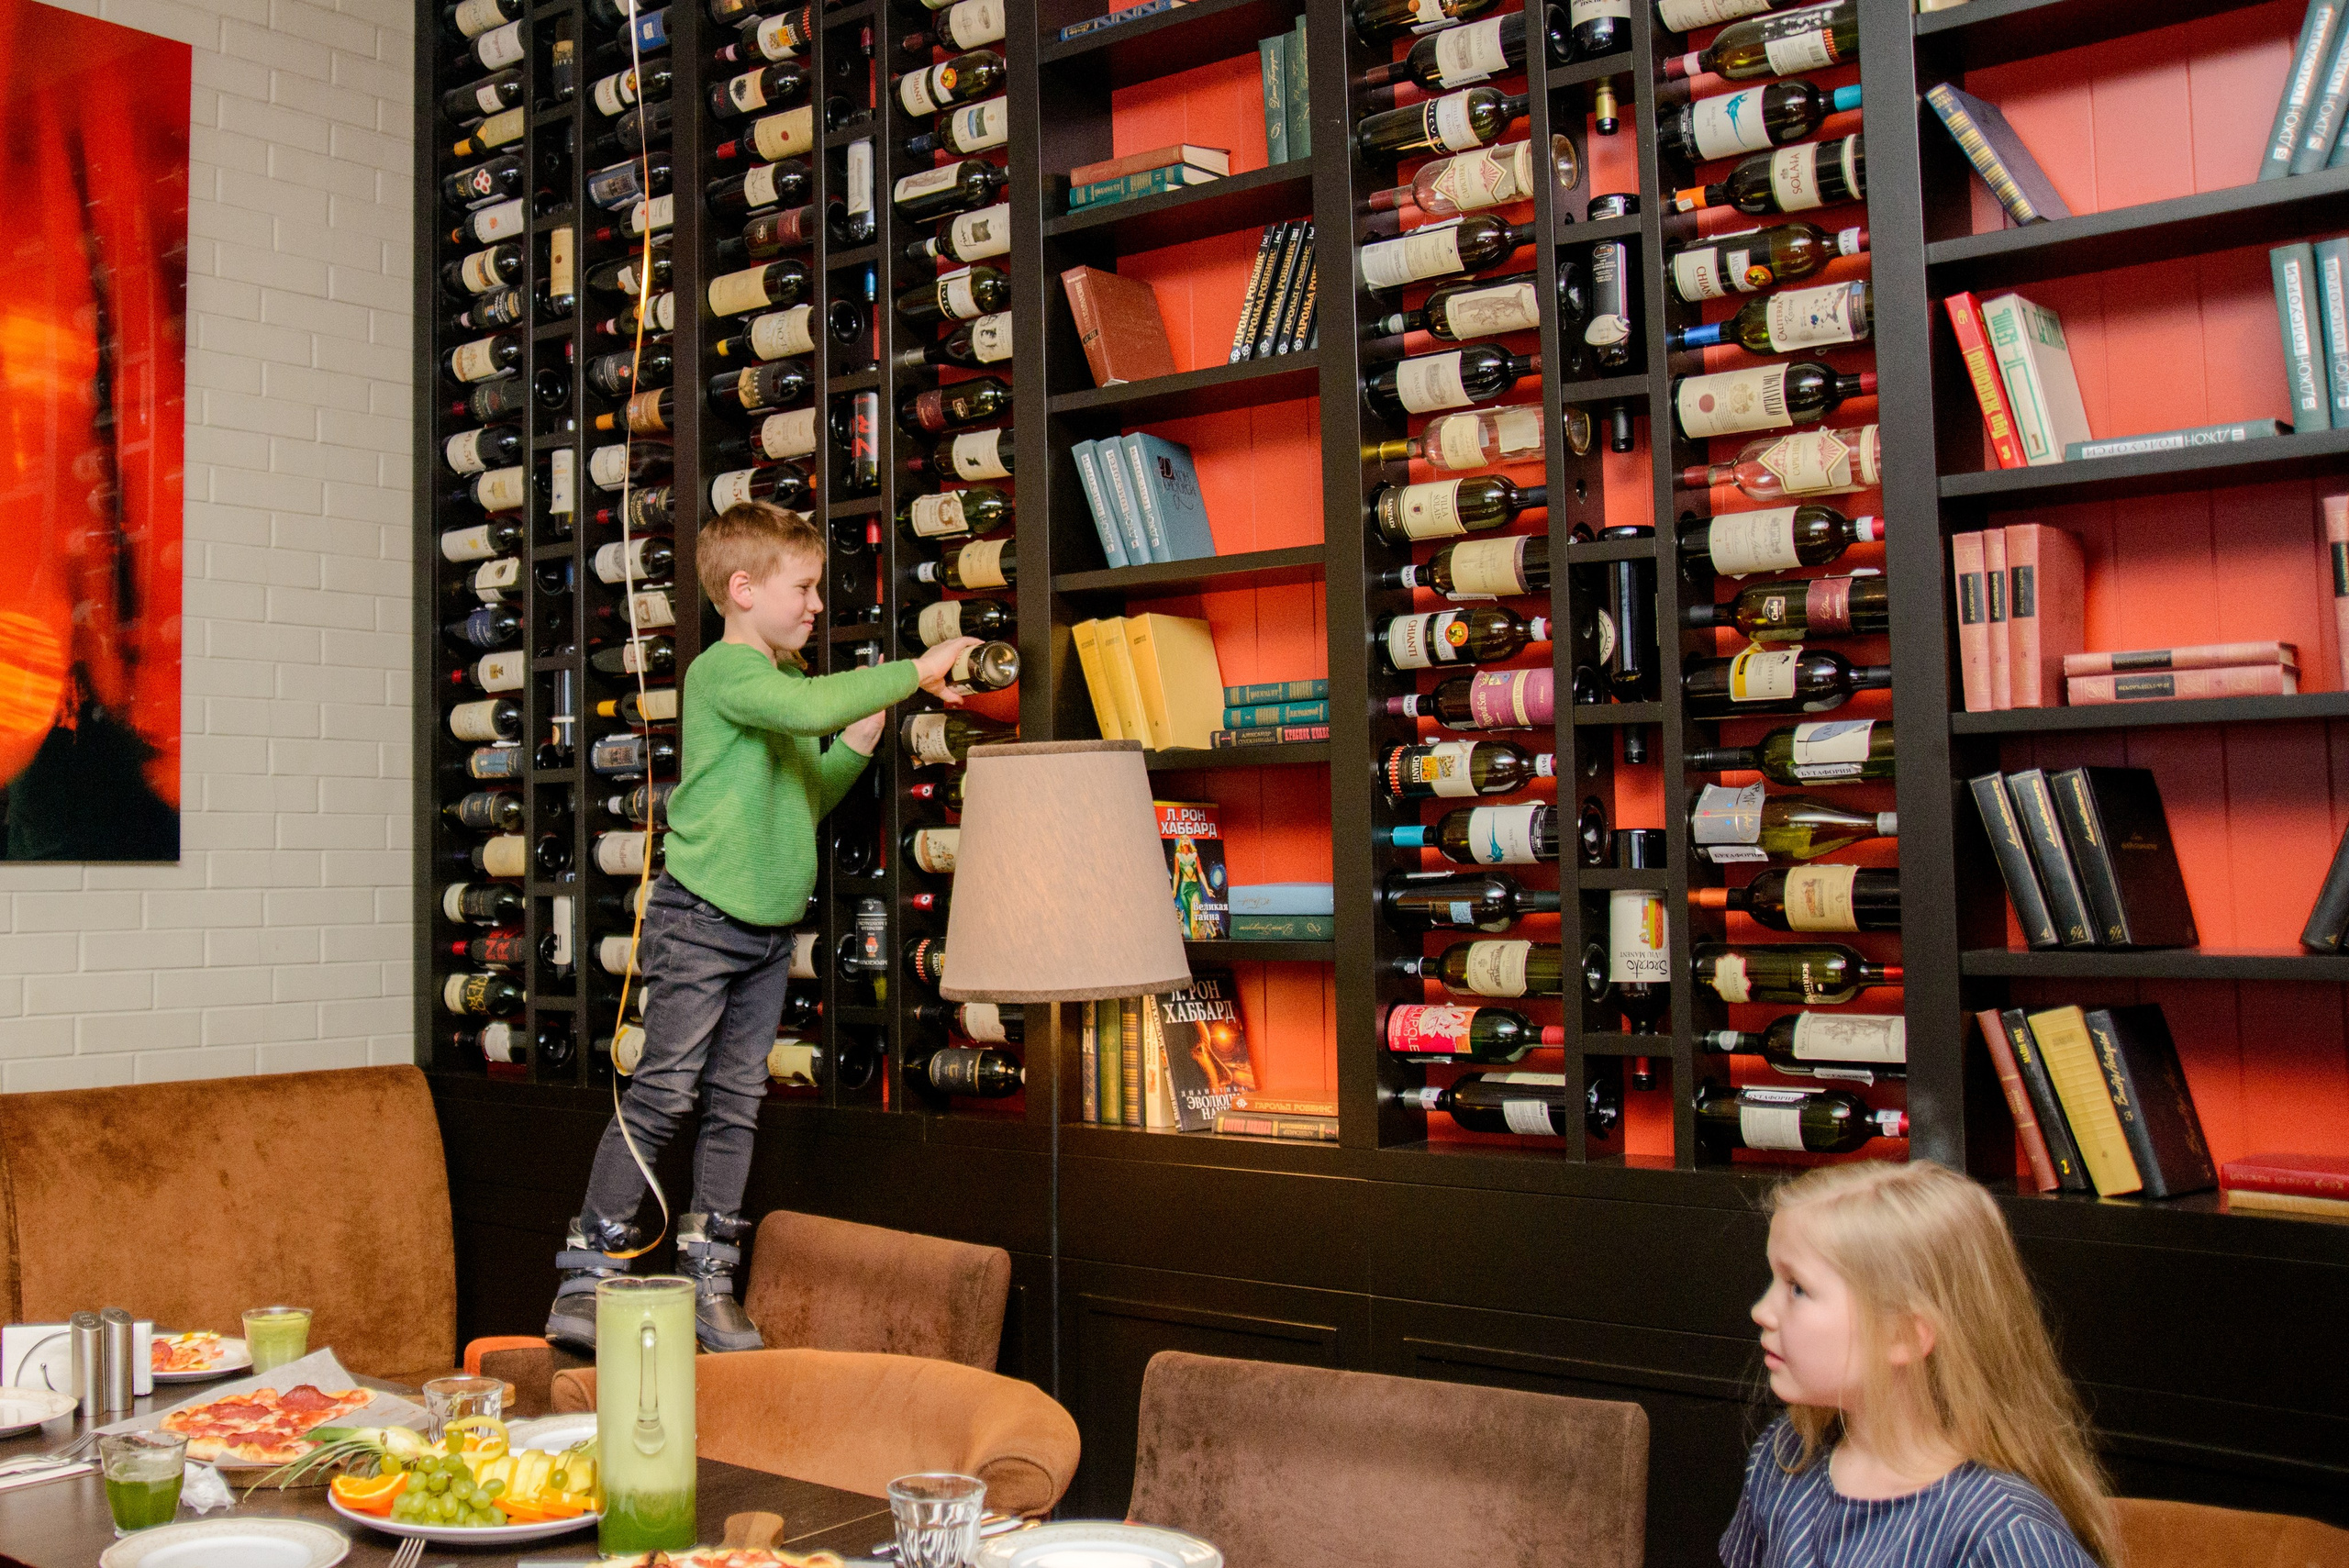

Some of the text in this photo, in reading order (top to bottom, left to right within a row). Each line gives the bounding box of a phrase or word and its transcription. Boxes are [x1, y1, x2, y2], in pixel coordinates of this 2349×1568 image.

[912, 73, 923, 105] CHIANTI
[2279, 7, 2332, 149] ДЖОН ГОЛСУОРСИ
[2317, 90, 2340, 137] ДЖОН
[1458, 163, 1470, 200] CAPICHERA
[1791, 152, 1803, 195] SOLAIA
[1232, 251, 1266, 347] ГАРОЛЬД РОББИНС
[1245, 249, 1276, 345] ГАРОЛЬД РОББИНС
[1264, 240, 1297, 337] ГАРОЛЬД РОББИНС
[1284, 245, 1311, 335] ГАРОЛЬД РОББИНС
[2324, 257, 2349, 354] ГОЛСУОРСИ
[1297, 290, 1312, 339] ГАРОЛЬД
[1776, 300, 1787, 342] CALITERRA
[2285, 260, 2315, 398] ДЖОН ГОЛСУОРСИ
[1764, 373, 1783, 417] TIGNANELLO
[1965, 350, 2000, 415] ЖАКОЛИО
[1793, 439, 1801, 476] CAPICHERA
[2082, 428, 2231, 459] ДЖОН ГОЛСУОРСИ
[1082, 453, 1114, 544] ДЖОН ГОЛСУОРСИ
[1106, 450, 1138, 540] ДЖОН ГОЛСУОРСИ
[1129, 446, 1159, 538] ДЖОН ГОЛСУОРСИ
[1432, 494, 1442, 521] SOLAIS
[1440, 494, 1448, 517] VILLA
[1386, 497, 1397, 529] SANTADI
[1771, 599, 1779, 621] Cielo
[1408, 619, 1419, 658] CHIANTI
[1284, 728, 1309, 742] КРАСНОЕ
[1412, 754, 1421, 784] CHIANTI
[1800, 767, 1853, 777] БУТАФОРИЯ
[1161, 820, 1218, 838] ХАББАРД
[1166, 807, 1206, 823] Л. РОН
[1193, 901, 1229, 912] Великая
[1193, 910, 1219, 922] тайна
[933, 952, 941, 977] CHIANTI
[1627, 959, 1667, 979] Secreto
[1188, 981, 1219, 1000] РОН
[1163, 1001, 1236, 1024] ХАББАРД
[1254, 1101, 1333, 1114] ГАРОЛЬД РОББИНС
[2123, 1109, 2134, 1121] 3
